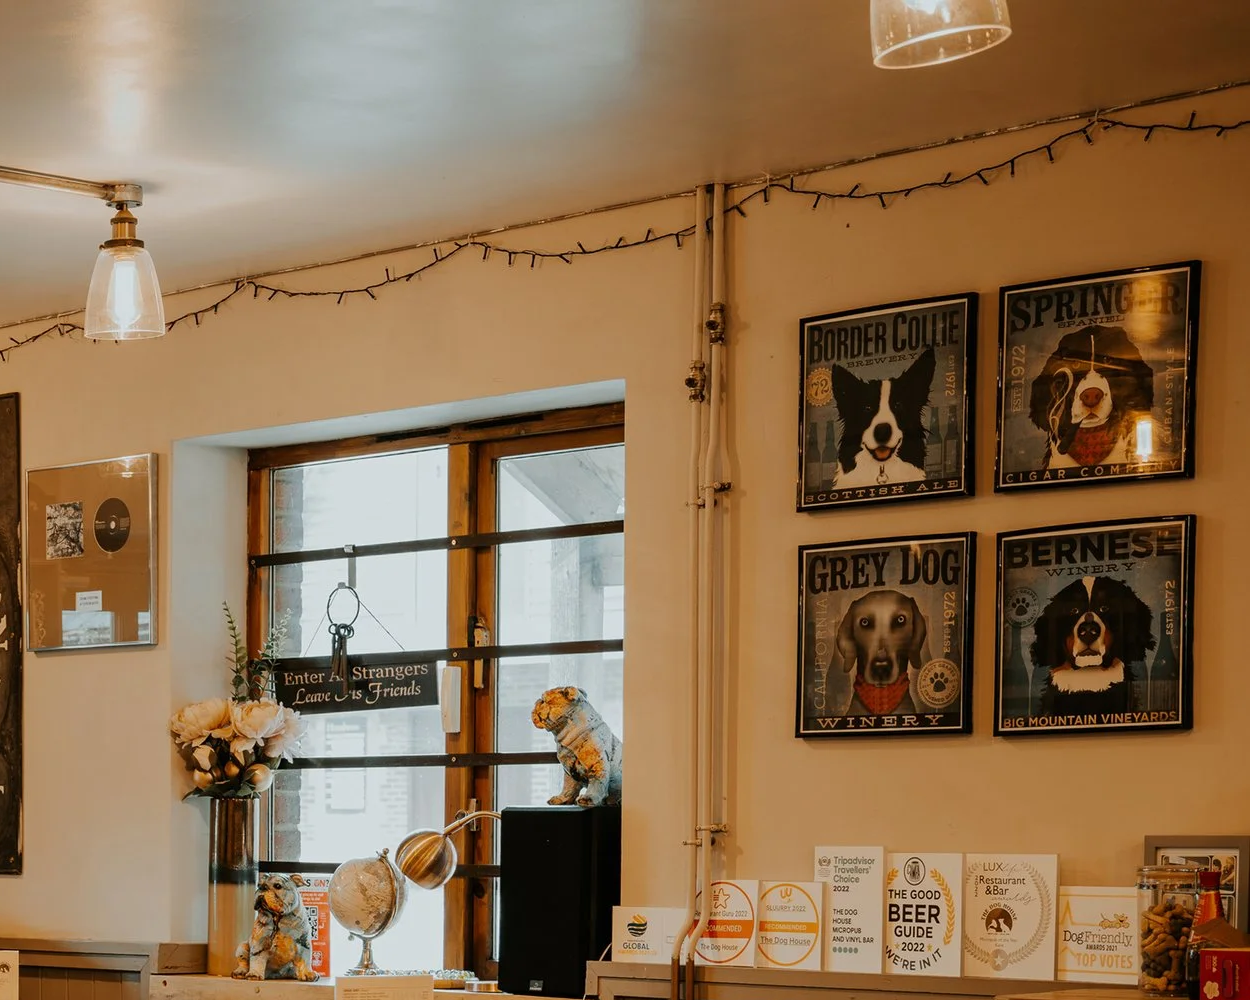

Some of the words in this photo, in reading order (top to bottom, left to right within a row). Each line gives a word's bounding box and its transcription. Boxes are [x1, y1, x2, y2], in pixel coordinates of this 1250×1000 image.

[1010, 281, 1183, 336] SPRINGER
[1058, 315, 1126, 329] SPANIEL
[809, 321, 886, 365] BORDER
[892, 310, 960, 352] COLLIE
[846, 352, 918, 368] BREWERY
[1012, 344, 1025, 386] 1972
[811, 378, 830, 396] 72
[945, 371, 956, 396] 1972
[1164, 347, 1174, 444] CUBAN-STYLE
[1005, 469, 1066, 484] CIGAR
[805, 485, 905, 503] SCOTTISH
[916, 480, 959, 492] ALE
[1006, 529, 1180, 570] BERNESE
[808, 552, 890, 595] GREY
[899, 549, 962, 586] DOG
[1045, 562, 1137, 577] WINERY
[1165, 580, 1176, 612] 1972
[943, 591, 956, 626] 1972
[814, 598, 828, 710] CALIFORNIA
[283, 672, 325, 686] Enter
[352, 663, 429, 682] Strangers
[292, 688, 331, 706] Leave
[365, 680, 421, 705] Friends
[817, 714, 944, 729] WINERY
[1003, 717, 1025, 728] BIG
[1028, 713, 1097, 727] MOUNTAIN
[1101, 711, 1177, 724] VINEYARDS
[833, 856, 875, 866] Tripadvisor
[833, 866, 871, 874] Travellers'
[833, 875, 860, 883] Choice
[979, 875, 1026, 885] Restaurant
[888, 889, 908, 899] THE
[910, 889, 941, 900] GOOD
[985, 885, 1009, 895] &Bar
[888, 903, 941, 924] BEER
[894, 925, 933, 938] GUIDE
[622, 942, 650, 950] GLOBAL
[711, 943, 721, 952] Dog
[760, 936, 773, 945] The
[774, 936, 788, 946] Dog
[789, 937, 811, 946] House
[901, 942, 925, 952] 2022
[885, 946, 916, 971] WE'RE
[919, 957, 932, 970] IN
[931, 948, 943, 963] IT
[1076, 952, 1097, 967] TOP
[1100, 954, 1133, 969] VOTES
